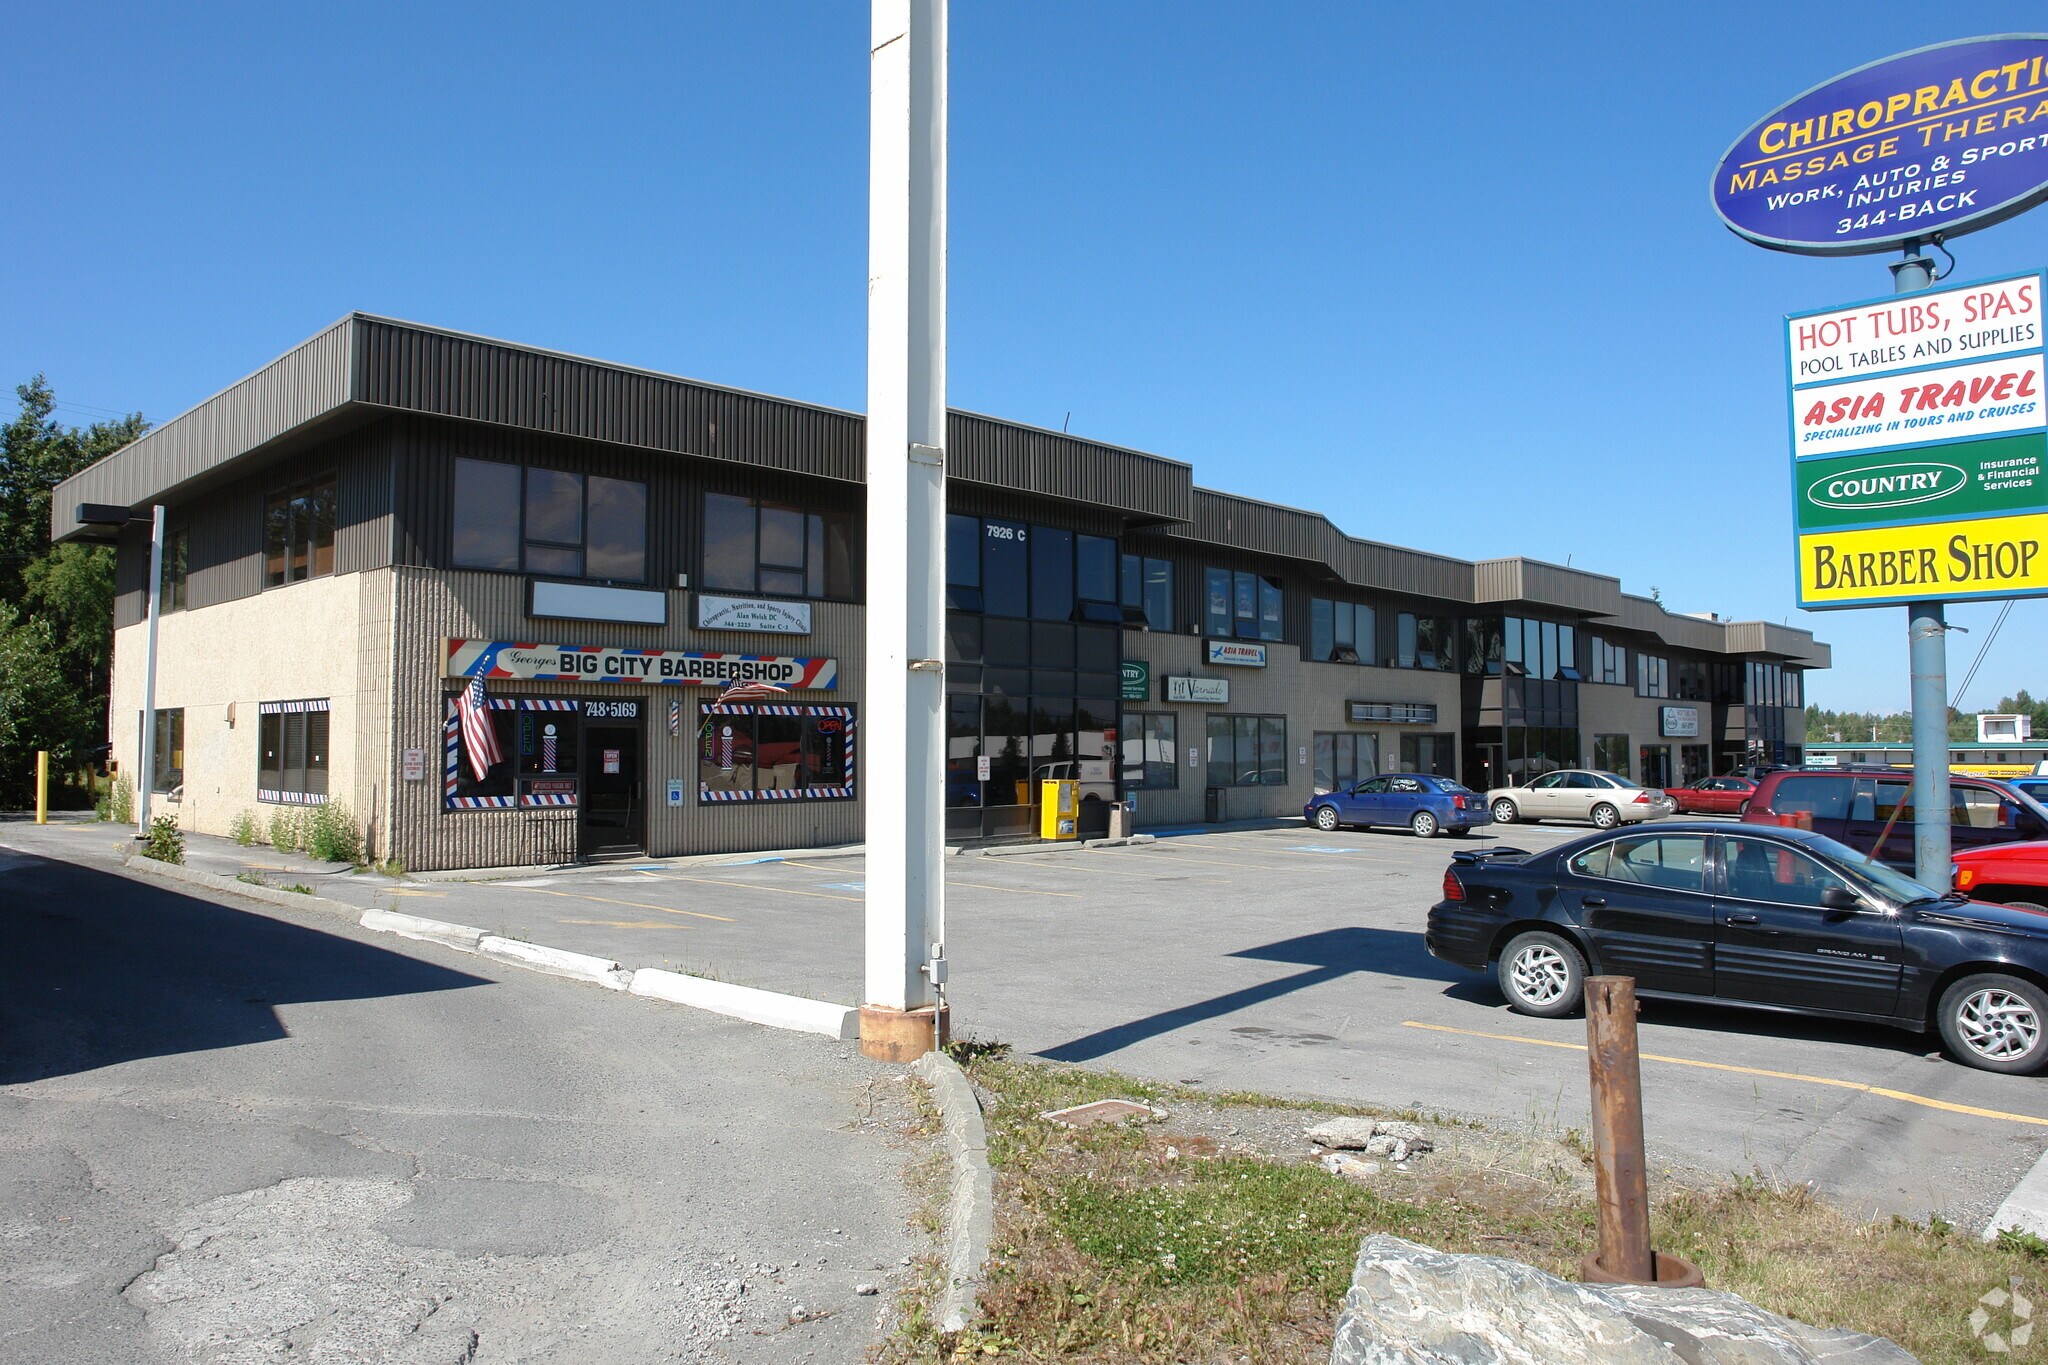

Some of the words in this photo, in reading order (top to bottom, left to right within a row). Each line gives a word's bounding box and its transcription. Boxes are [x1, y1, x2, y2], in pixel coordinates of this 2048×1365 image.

[1759, 56, 2048, 154] CHIROPRACTI
[1729, 137, 1900, 195] MASSAGE
[1766, 184, 1845, 212] WORK,
[1853, 164, 1921, 192] AUTO
[1931, 155, 1950, 171] &
[1846, 170, 1966, 209] INJURIES
[1836, 190, 1978, 234] 344-BACK
[1798, 316, 1858, 351] HOT
[1868, 302, 1951, 339] TUBS,
[1964, 284, 2033, 323] SPAS
[1800, 355, 1843, 376] POOL
[1849, 344, 1906, 367] TABLES
[1913, 338, 1952, 358] AND
[1960, 323, 2036, 350] SUPPLIES
[1804, 392, 1885, 426] ASIA
[1900, 370, 2036, 414] TRAVEL
[1804, 422, 1882, 442] SPECIALIZING
[1886, 420, 1900, 432] IN
[1904, 414, 1944, 429] TOURS
[1948, 410, 1974, 423] AND
[1979, 402, 2036, 419] CRUISES
[1980, 456, 2037, 470] Insurance
[1987, 466, 2039, 480] Financial
[1828, 470, 1943, 498] COUNTRY
[1984, 479, 2033, 490] Services
[986, 525, 1013, 540] 7926
[1018, 530, 1026, 541] C
[1813, 545, 1940, 590] BARBER
[1947, 535, 2039, 582] SHOP
[767, 604, 781, 614] Sports
[510, 650, 556, 670] Georges
[560, 654, 598, 674] BIG
[604, 656, 653, 676] CITY
[660, 658, 794, 680] BARBERSHOP
[1224, 646, 1237, 654] ASIA
[1238, 648, 1258, 656] TRAVEL
[522, 716, 532, 752] OPEN
[705, 723, 713, 757] OPEN
[817, 719, 842, 731] OPEN
